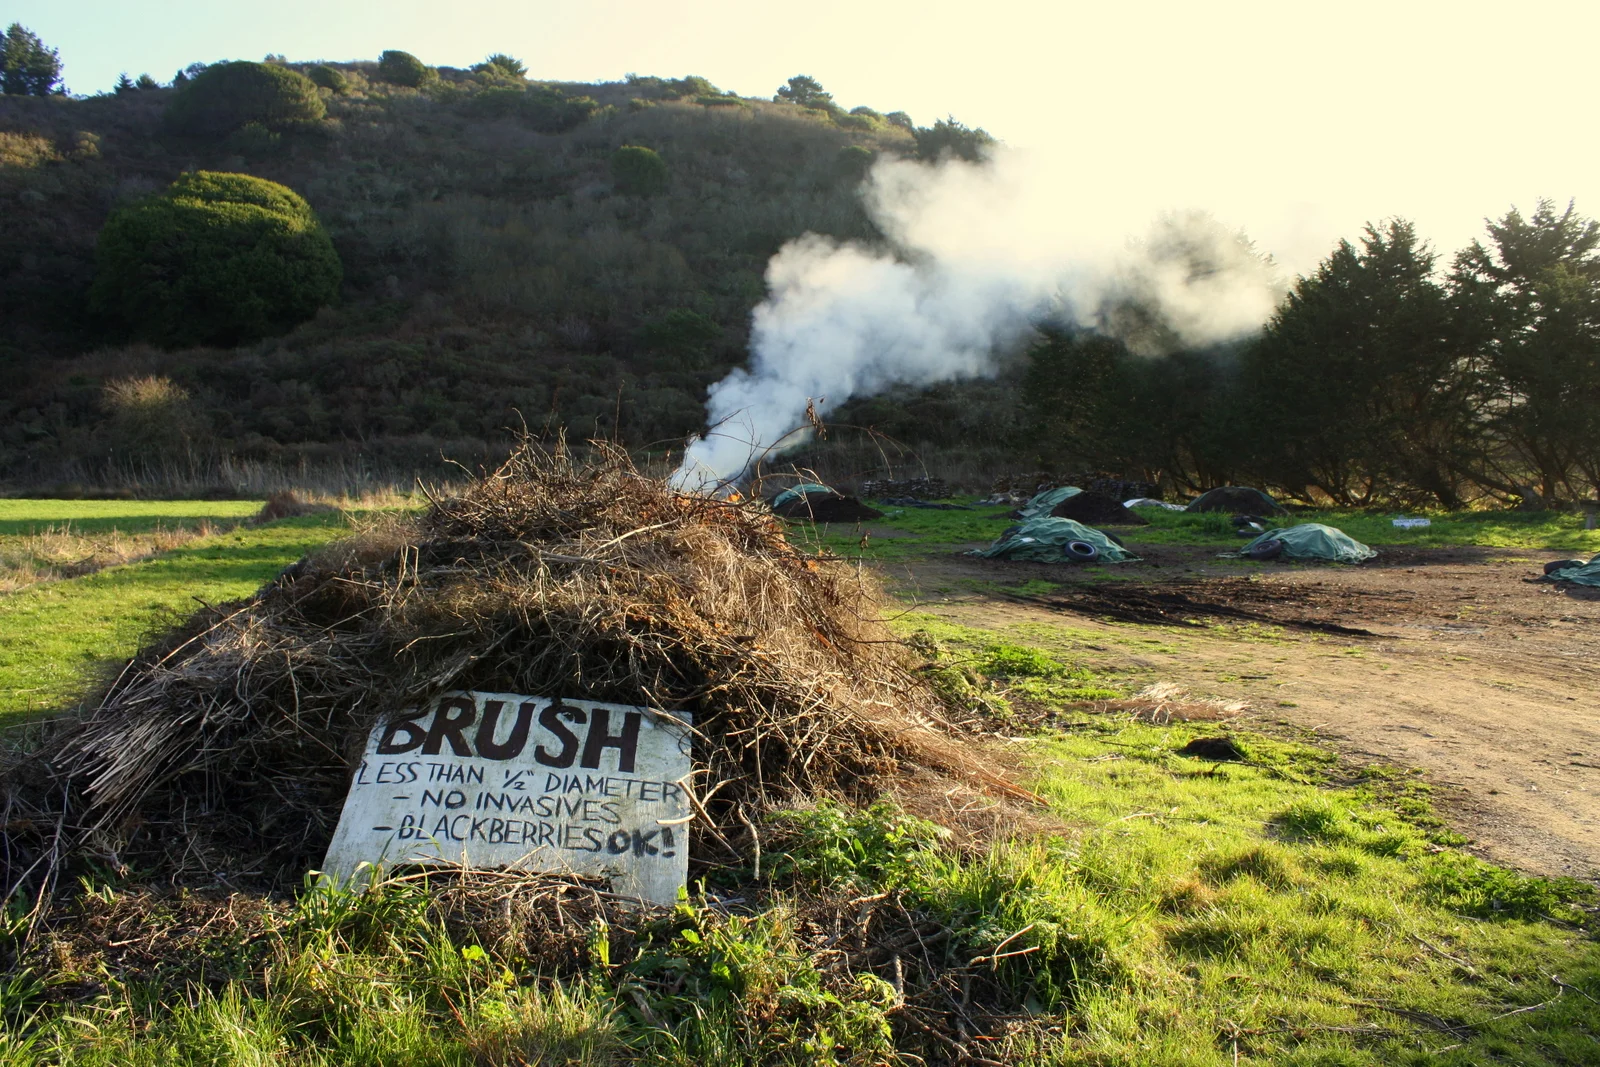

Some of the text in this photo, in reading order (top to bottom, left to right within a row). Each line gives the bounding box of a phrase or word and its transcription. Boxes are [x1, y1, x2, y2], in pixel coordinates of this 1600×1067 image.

[376, 697, 642, 773] BRUSH
[357, 761, 423, 785] LESS
[427, 763, 485, 784] THAN
[544, 773, 681, 803] DIAMETER
[421, 789, 466, 809] NO
[476, 791, 622, 824] INVASIVES
[397, 814, 603, 853] BLACKBERRIES
[607, 826, 676, 859] OK!
